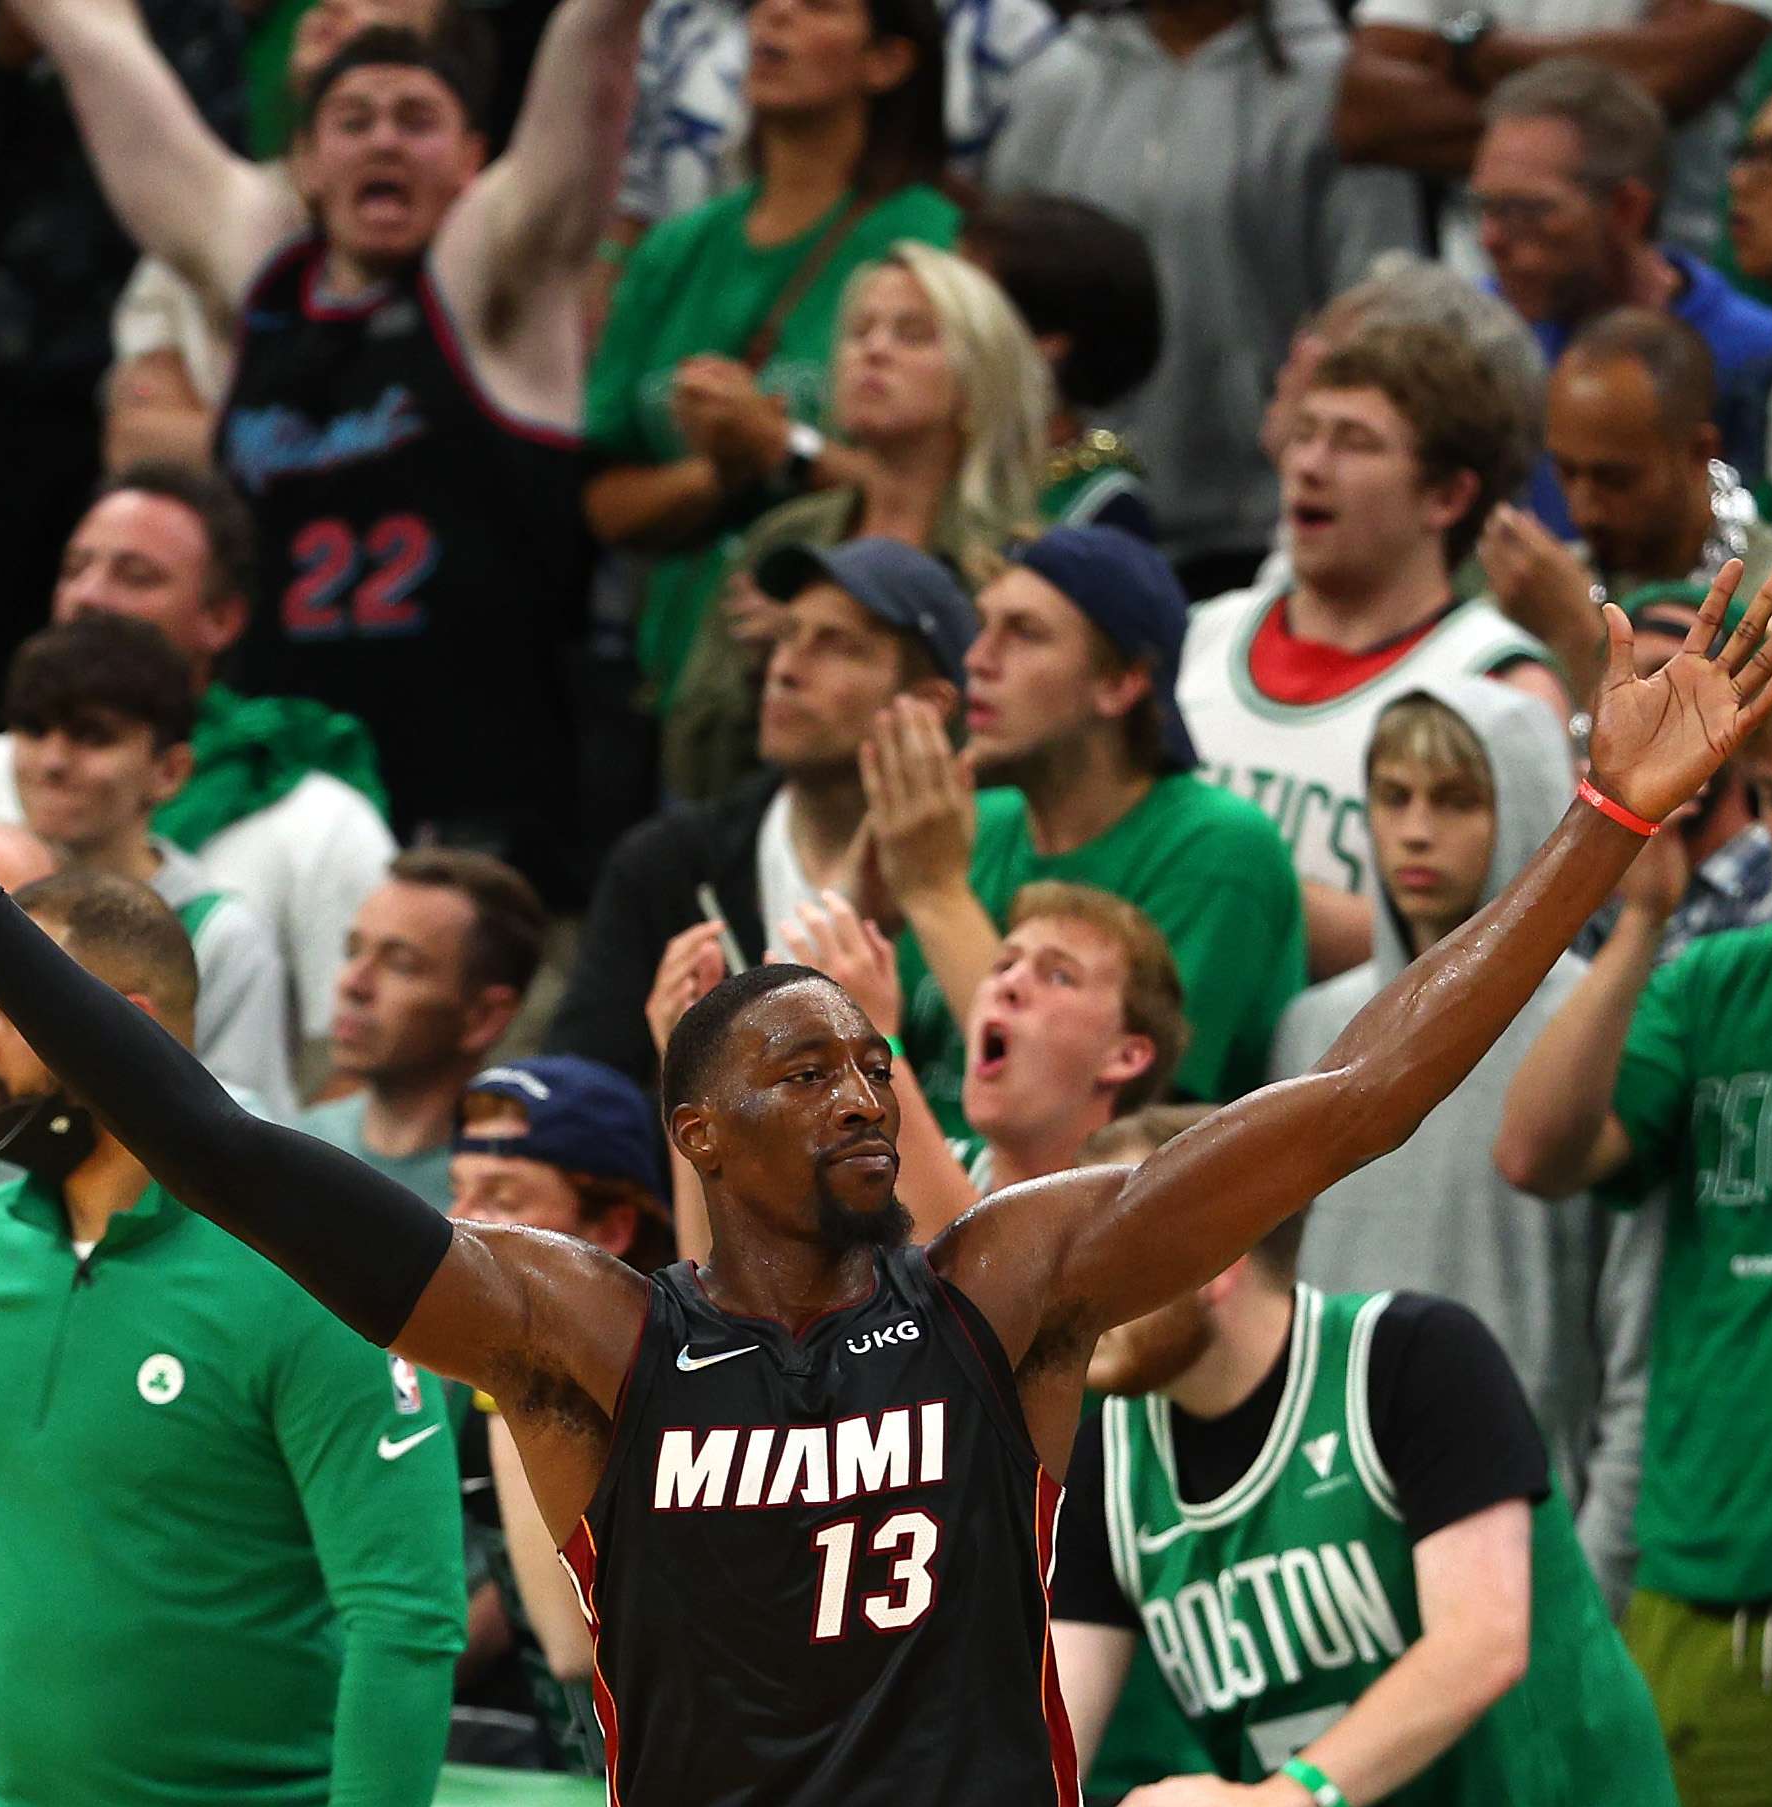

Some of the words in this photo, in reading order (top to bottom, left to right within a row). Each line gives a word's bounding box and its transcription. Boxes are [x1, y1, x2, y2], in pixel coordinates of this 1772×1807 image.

[281, 514, 443, 642] 22
[846, 1320, 921, 1354] UKG
[650, 1398, 949, 1513] MIAMI
[809, 1506, 944, 1645] 13
[1140, 1539, 1407, 1719] BOSTON
